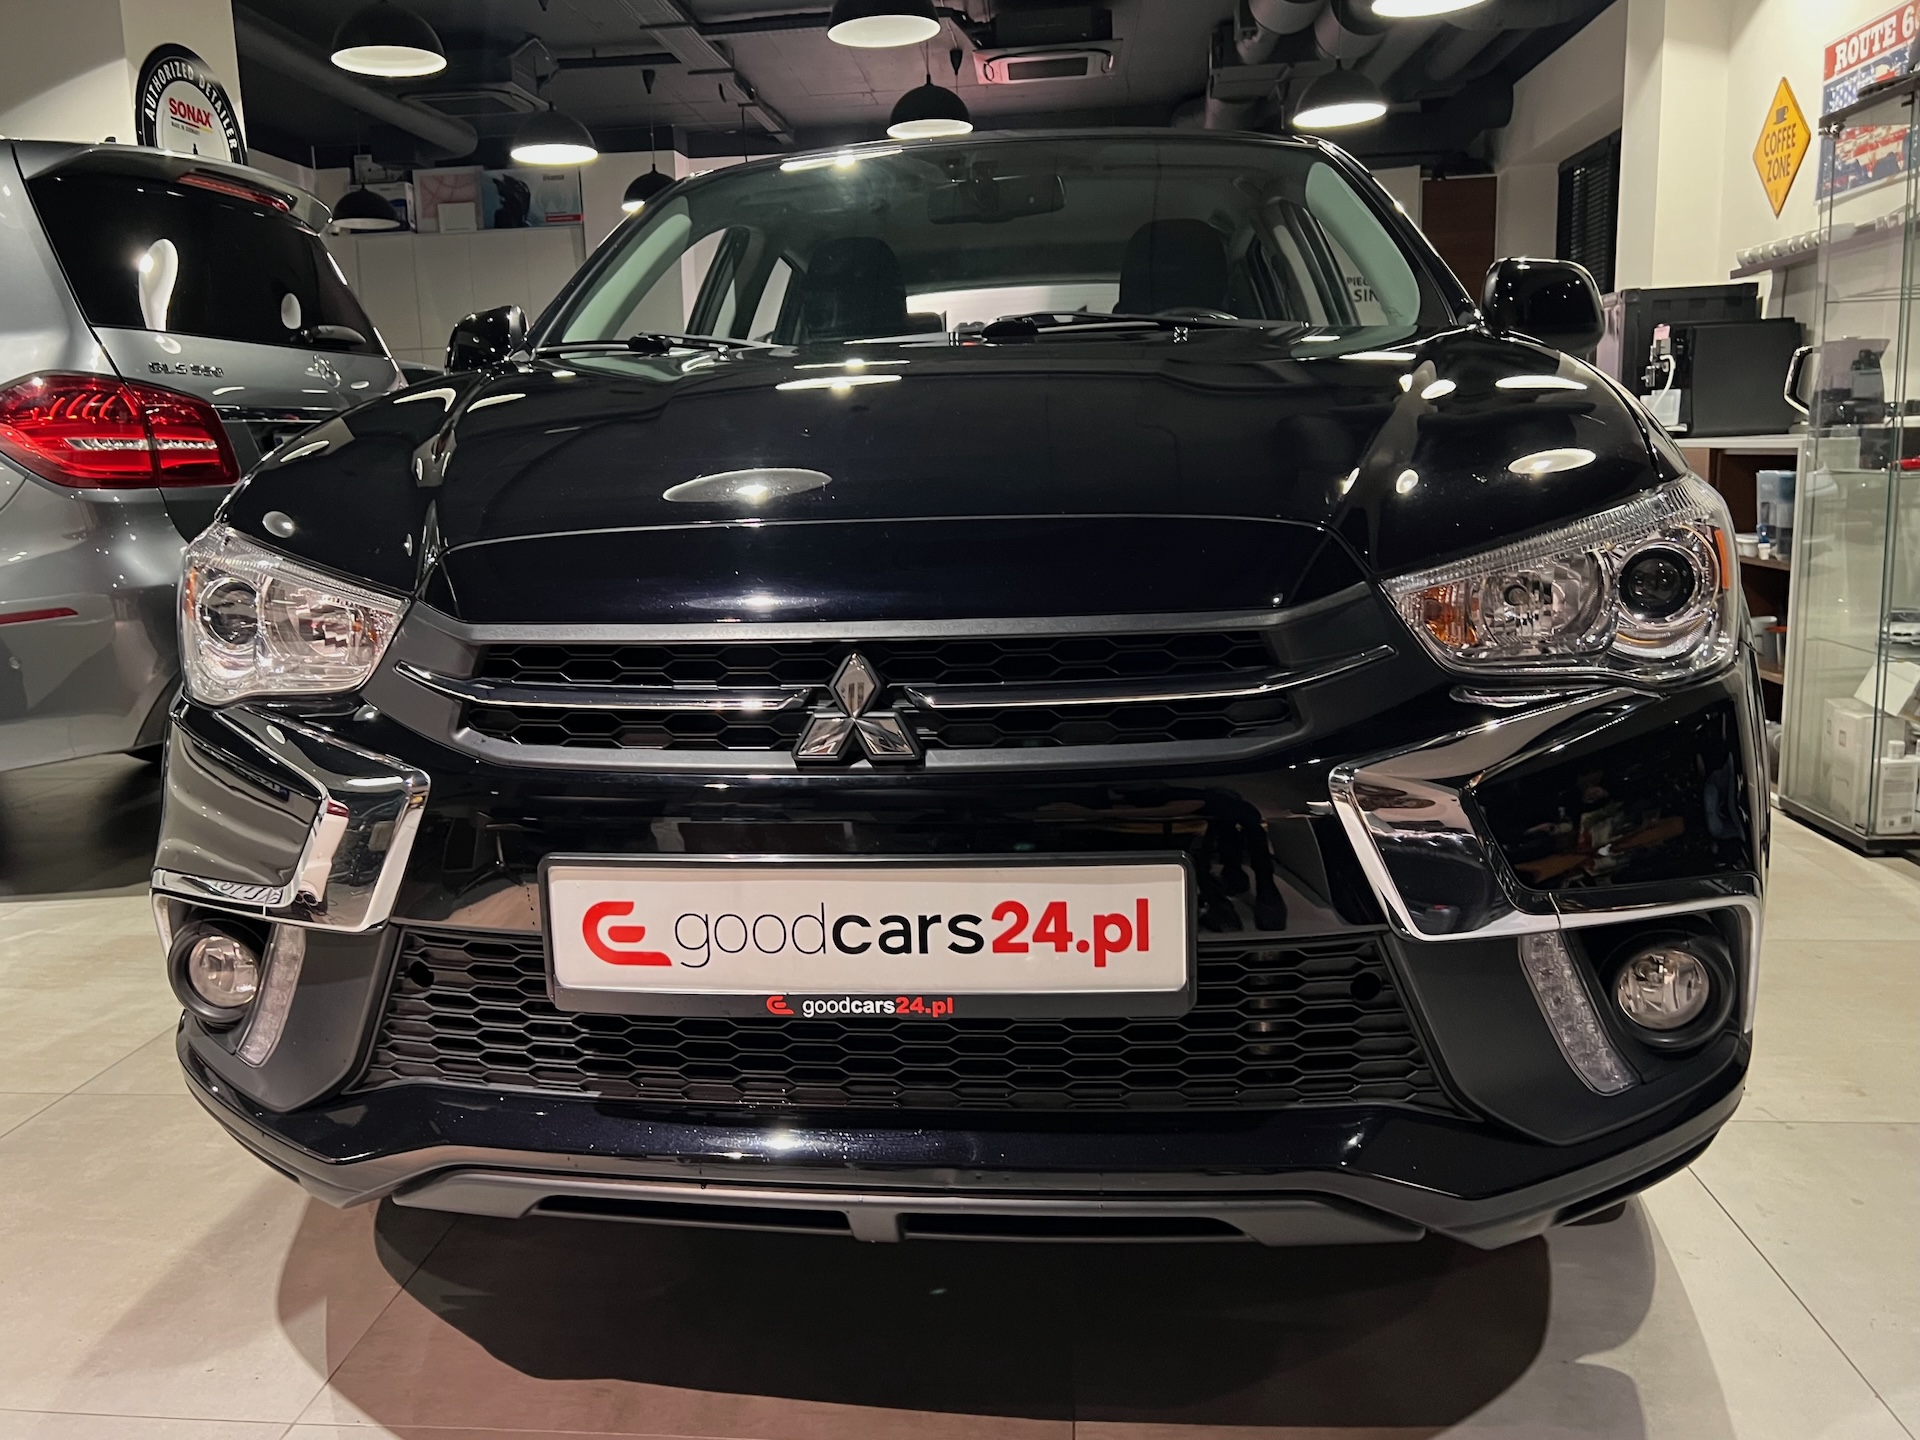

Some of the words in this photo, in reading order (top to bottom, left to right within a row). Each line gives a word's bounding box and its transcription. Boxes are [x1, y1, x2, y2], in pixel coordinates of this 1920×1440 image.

[1834, 14, 1897, 73] ROUTE
[145, 61, 194, 122] AUTHORIZED
[199, 74, 238, 149] DETAILER
[169, 97, 213, 128] SONAX
[1763, 122, 1797, 157] COFFEE
[1766, 153, 1791, 183] ZONE
[148, 361, 188, 375] GLS
[674, 897, 1149, 968] goodcars24.pl
[802, 996, 954, 1019] goodcars24.pl
